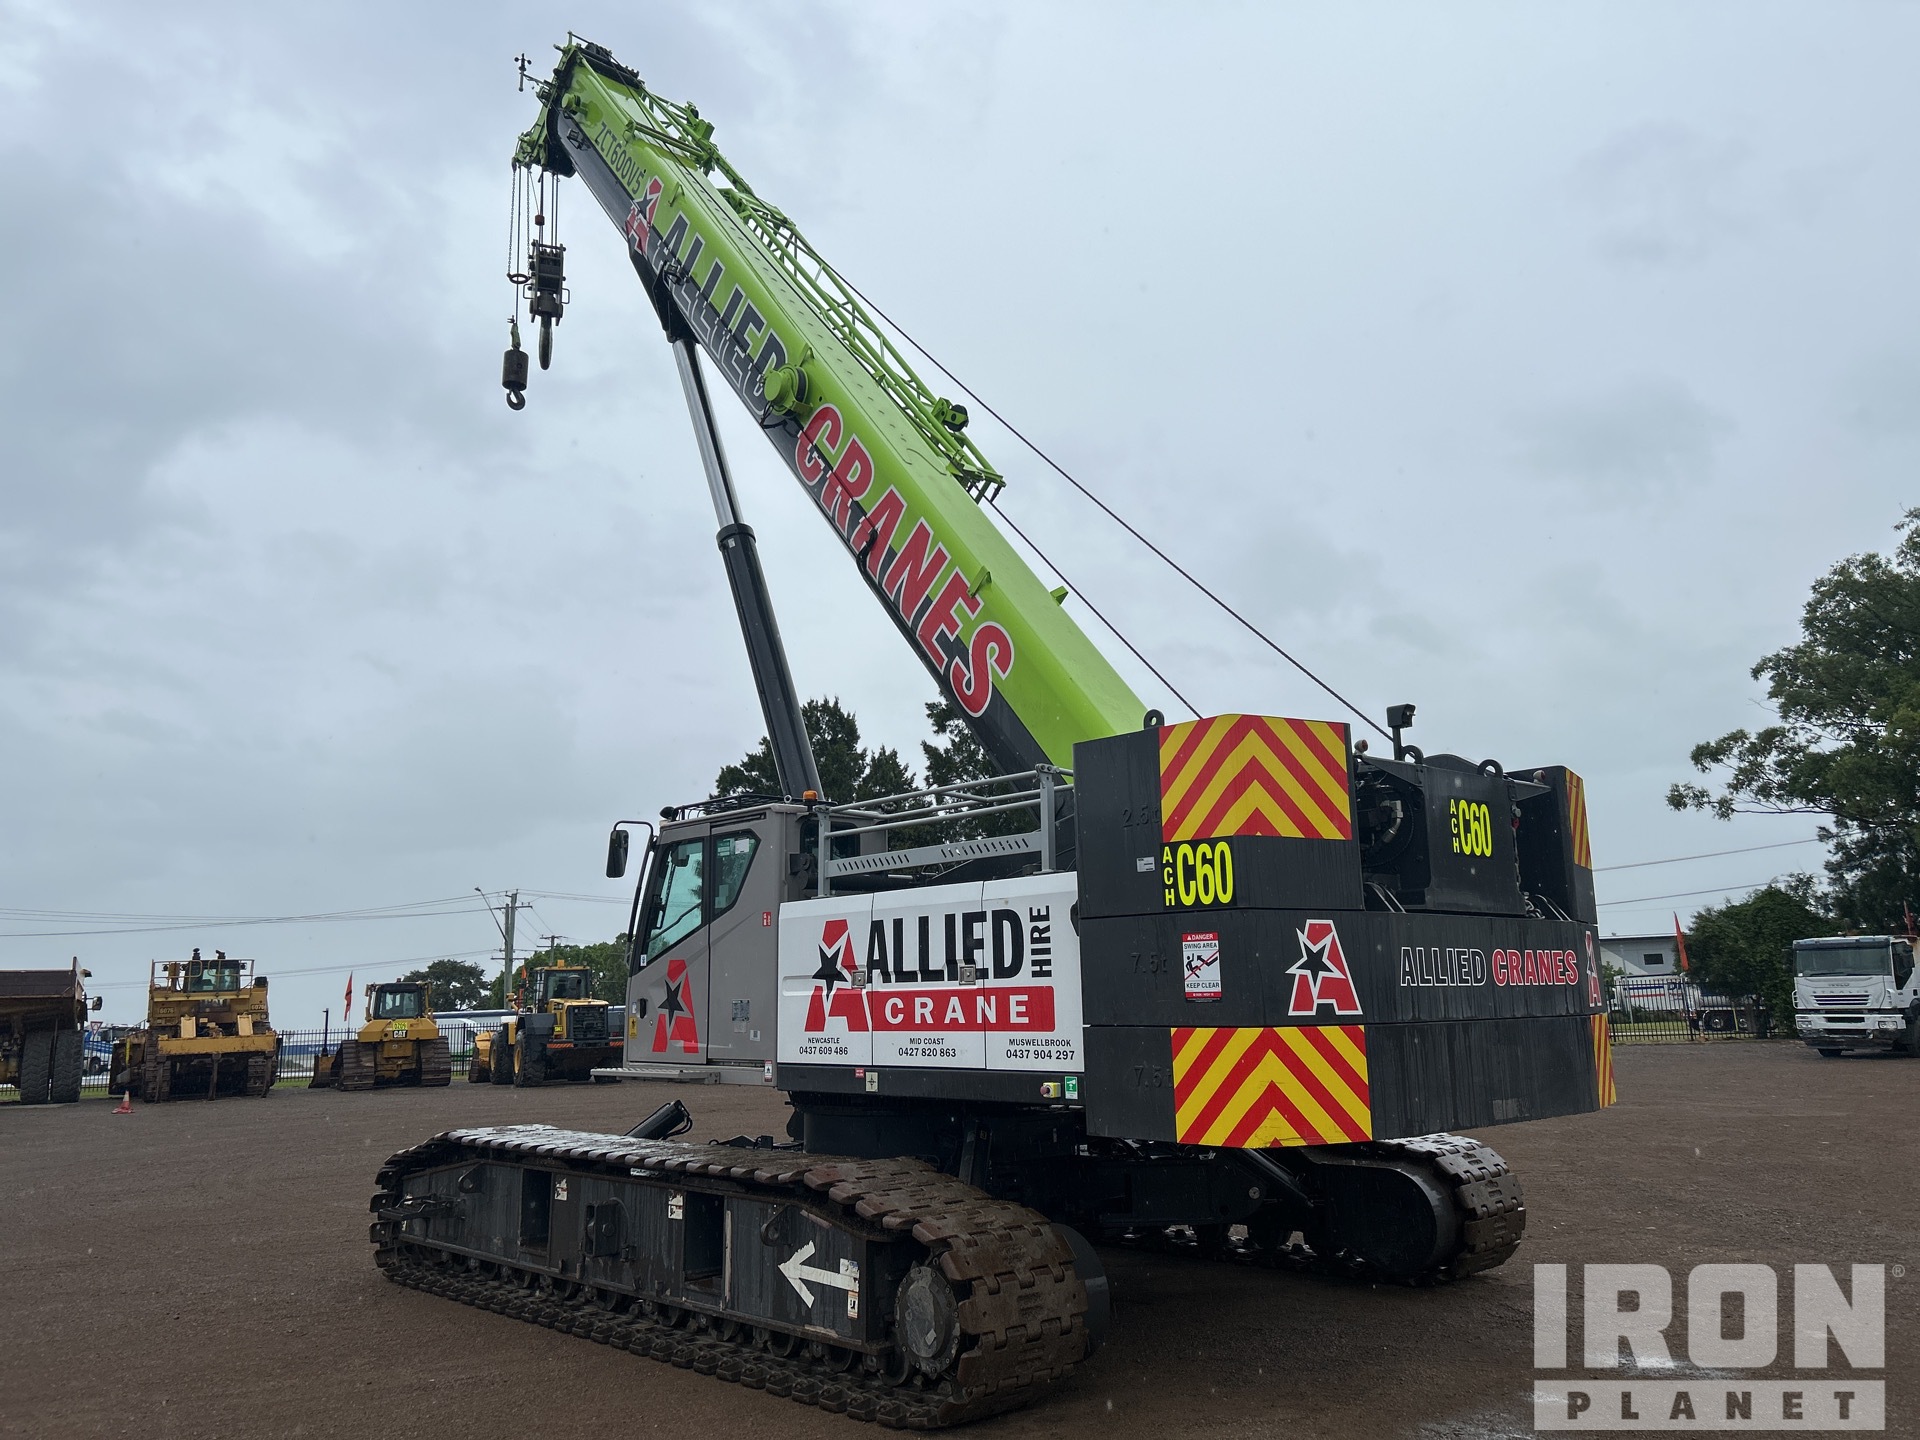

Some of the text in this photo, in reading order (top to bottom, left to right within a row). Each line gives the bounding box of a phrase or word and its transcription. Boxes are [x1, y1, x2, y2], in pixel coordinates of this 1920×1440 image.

[594, 121, 645, 195] ZCT600V5
[655, 211, 1015, 718] ALLIED CRANES
[1459, 799, 1492, 857] C60
[1176, 841, 1233, 906] C60
[867, 905, 1052, 984] ALLIED HIRE
[1191, 933, 1213, 941] DANGER
[1400, 947, 1578, 986] ALLIED CRANES
[884, 994, 1029, 1024] CRANE
[799, 1046, 848, 1056] 0437 609 486
[898, 1047, 956, 1058] 0427 820 863
[909, 1037, 944, 1045] MID COAST
[1006, 1049, 1075, 1061] 0437 904 297
[1008, 1038, 1071, 1047] MUSWELLBROOK
